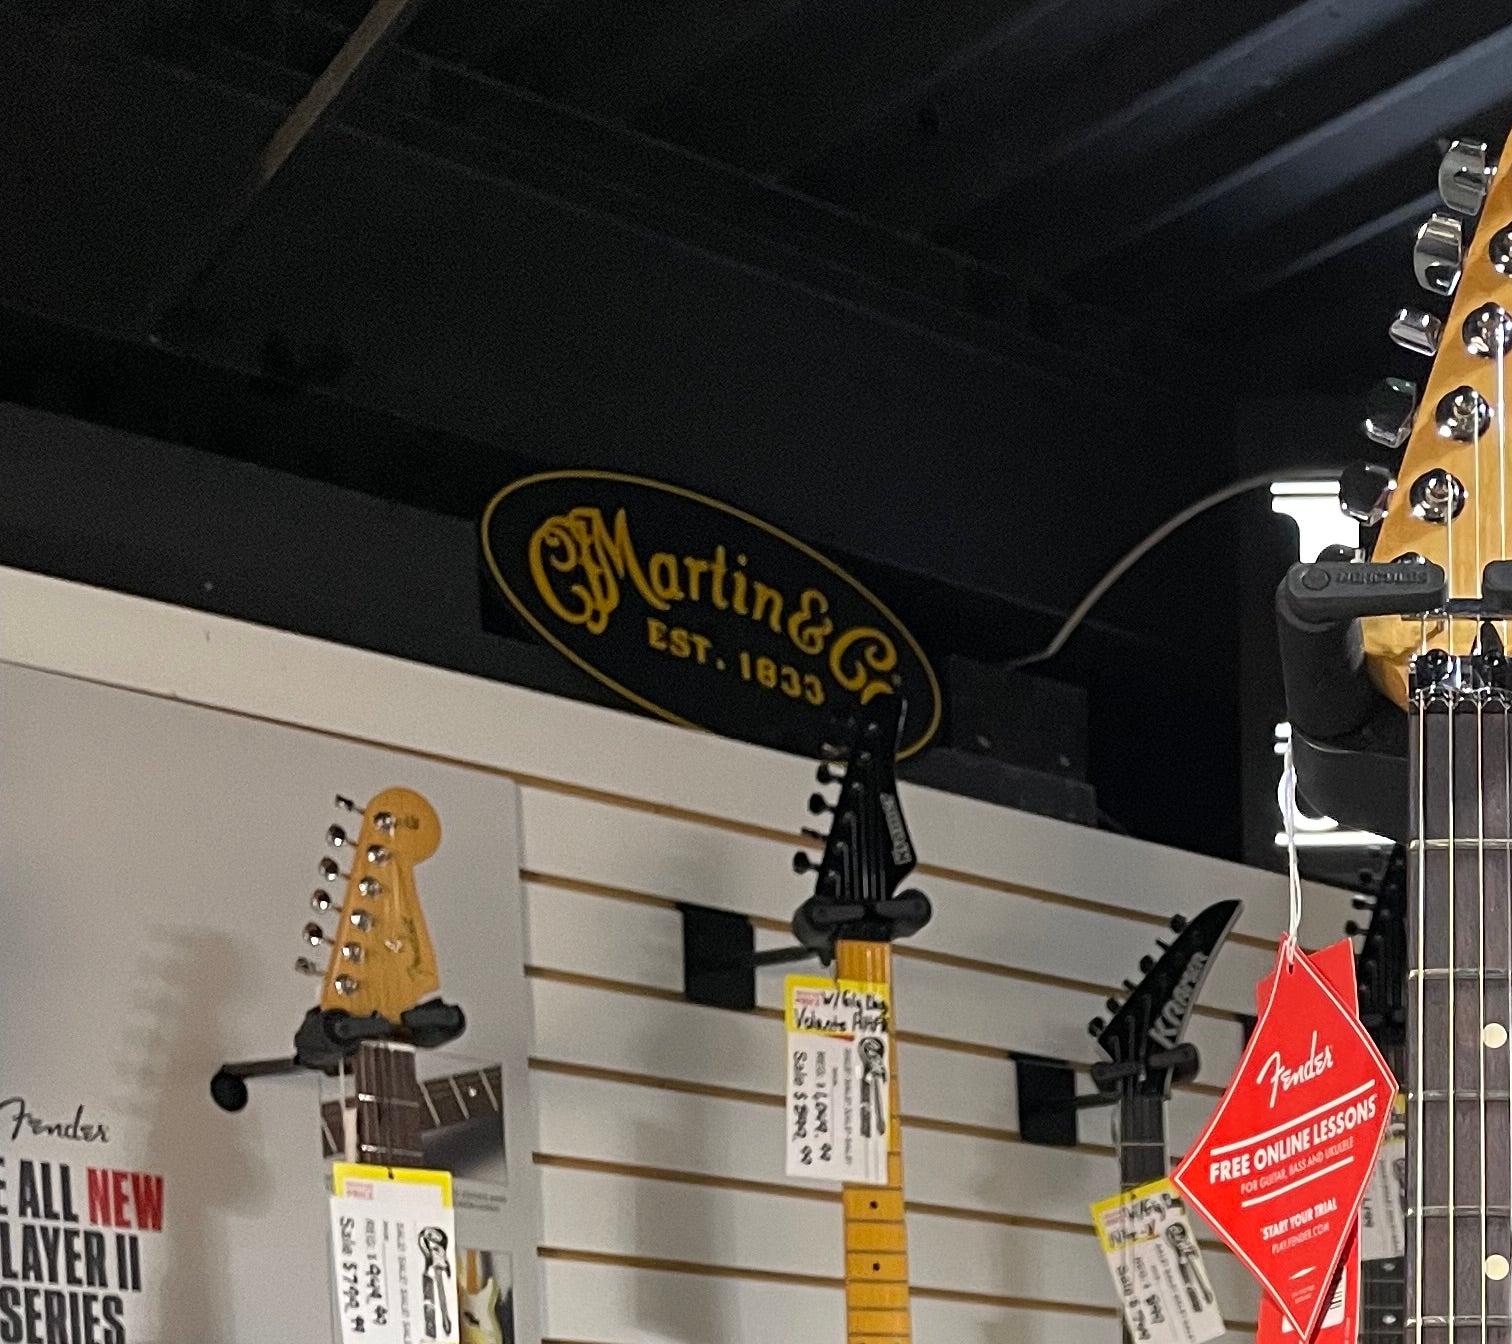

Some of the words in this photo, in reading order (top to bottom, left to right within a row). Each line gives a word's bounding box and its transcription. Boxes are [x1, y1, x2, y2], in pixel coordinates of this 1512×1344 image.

[647, 617, 727, 671] EST.
[739, 650, 826, 706] 1833
[1255, 1030, 1335, 1109] Fender
[0, 1096, 110, 1144] Fender
[1208, 1151, 1252, 1185] FREE
[1252, 1130, 1312, 1172] ONLINE
[1311, 1094, 1379, 1153] LESSONS
[18, 1157, 80, 1223] ALL
[86, 1165, 166, 1233] NEW
[1260, 1218, 1291, 1242] START
[0, 1220, 109, 1289] LAYER
[114, 1231, 143, 1293] II
